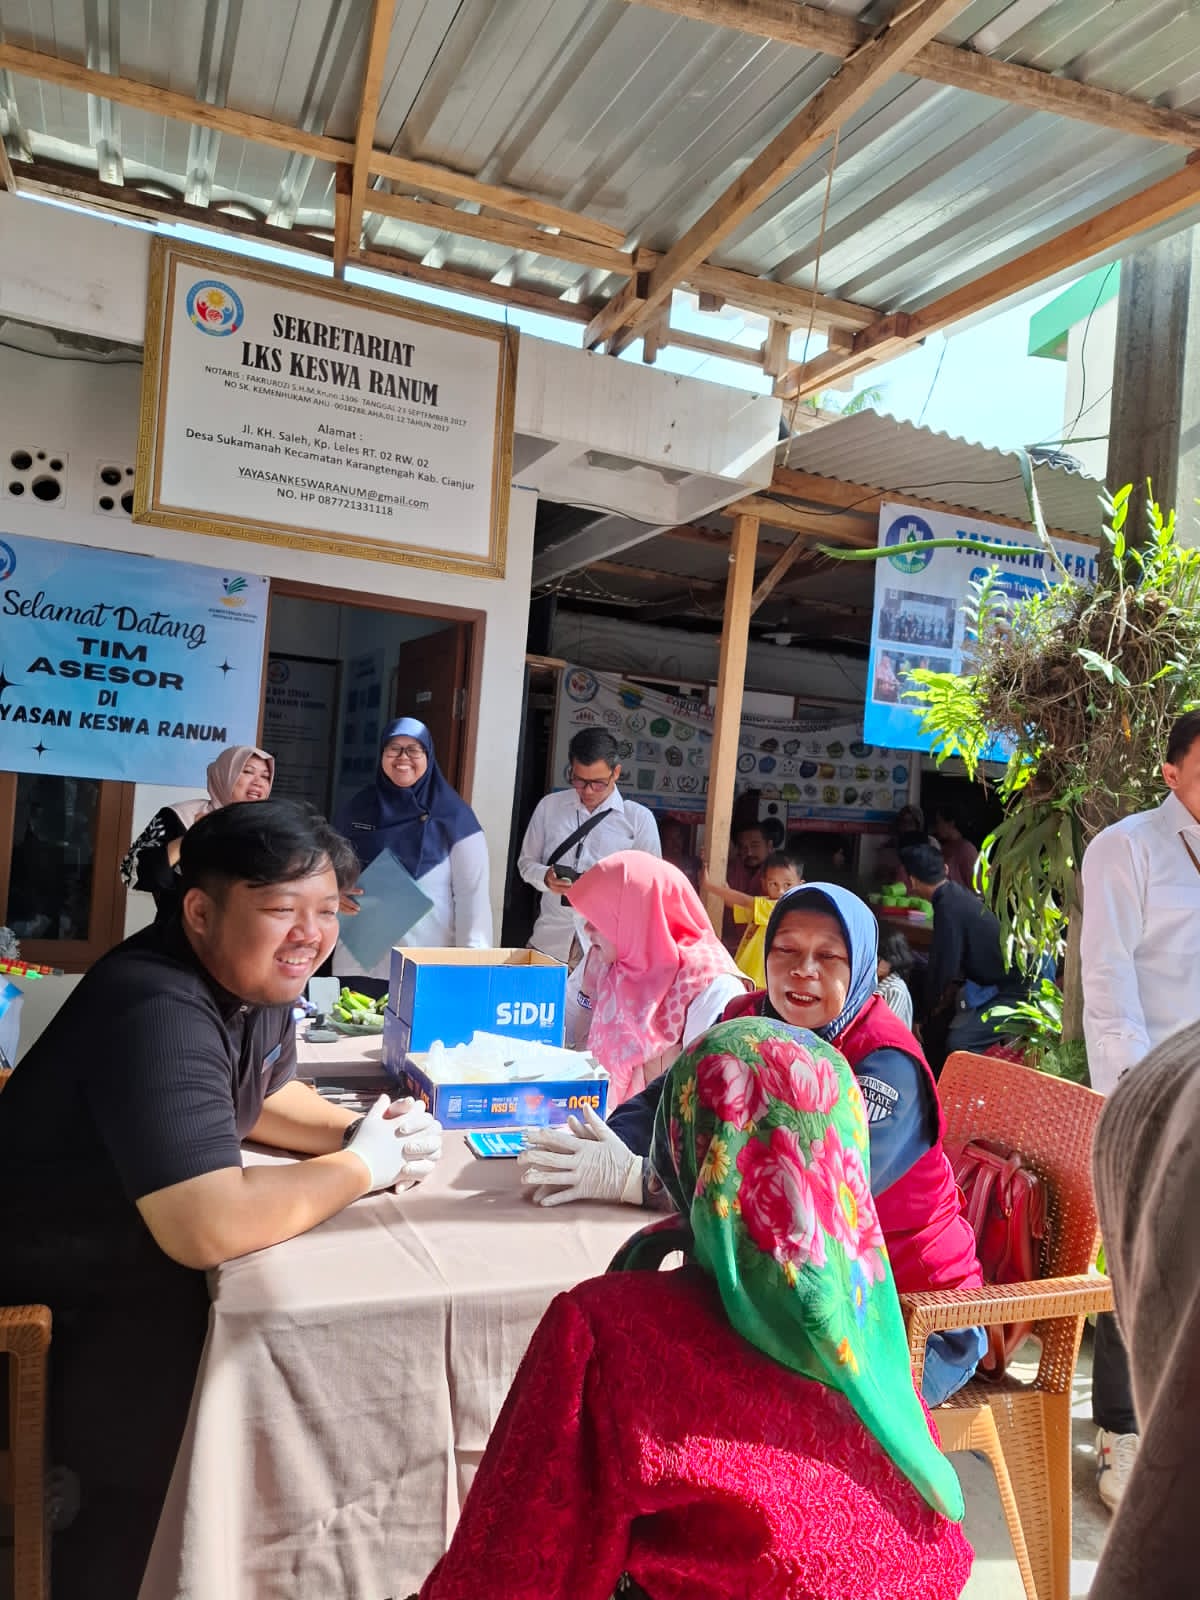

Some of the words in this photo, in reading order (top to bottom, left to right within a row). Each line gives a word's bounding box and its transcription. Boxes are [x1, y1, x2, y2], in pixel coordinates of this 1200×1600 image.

[272, 312, 415, 368] SEKRETARIAT
[205, 365, 240, 379] NOTARIS
[361, 398, 395, 411] TANGGAL
[408, 408, 449, 423] SEPTEMBER
[241, 341, 282, 373] LKS
[289, 351, 361, 391] KESWA
[368, 369, 439, 407] RANUM
[224, 379, 237, 388] NO
[407, 416, 432, 429] TAHUN
[432, 423, 449, 432] 2017
[256, 427, 276, 440] KH.
[279, 431, 312, 447] Saleh,
[334, 442, 360, 456] Leles
[363, 447, 377, 459] RT.
[380, 451, 393, 462] 02
[395, 454, 414, 467] RW.
[417, 458, 430, 469] 02
[317, 423, 356, 440] Alamat
[186, 428, 214, 443] Desa
[217, 433, 281, 455] Sukamanah
[284, 446, 343, 466] Kecamatan
[346, 457, 415, 480] Karangtengah
[418, 471, 440, 484] Kab.
[441, 476, 475, 491] Cianjur
[238, 466, 430, 511] YAYASANKESWARANUM@gmail.com
[277, 488, 297, 501] NO.
[300, 493, 316, 504] HP
[318, 495, 394, 516] 087721331118
[3, 590, 114, 628] Selamat
[113, 606, 208, 650] Datang
[77, 636, 148, 663] TIM
[26, 656, 185, 691] ASESOR
[98, 690, 118, 708] DI
[0, 703, 73, 728] YASAN
[79, 711, 150, 735] KESWA
[158, 720, 228, 743] RANUM
